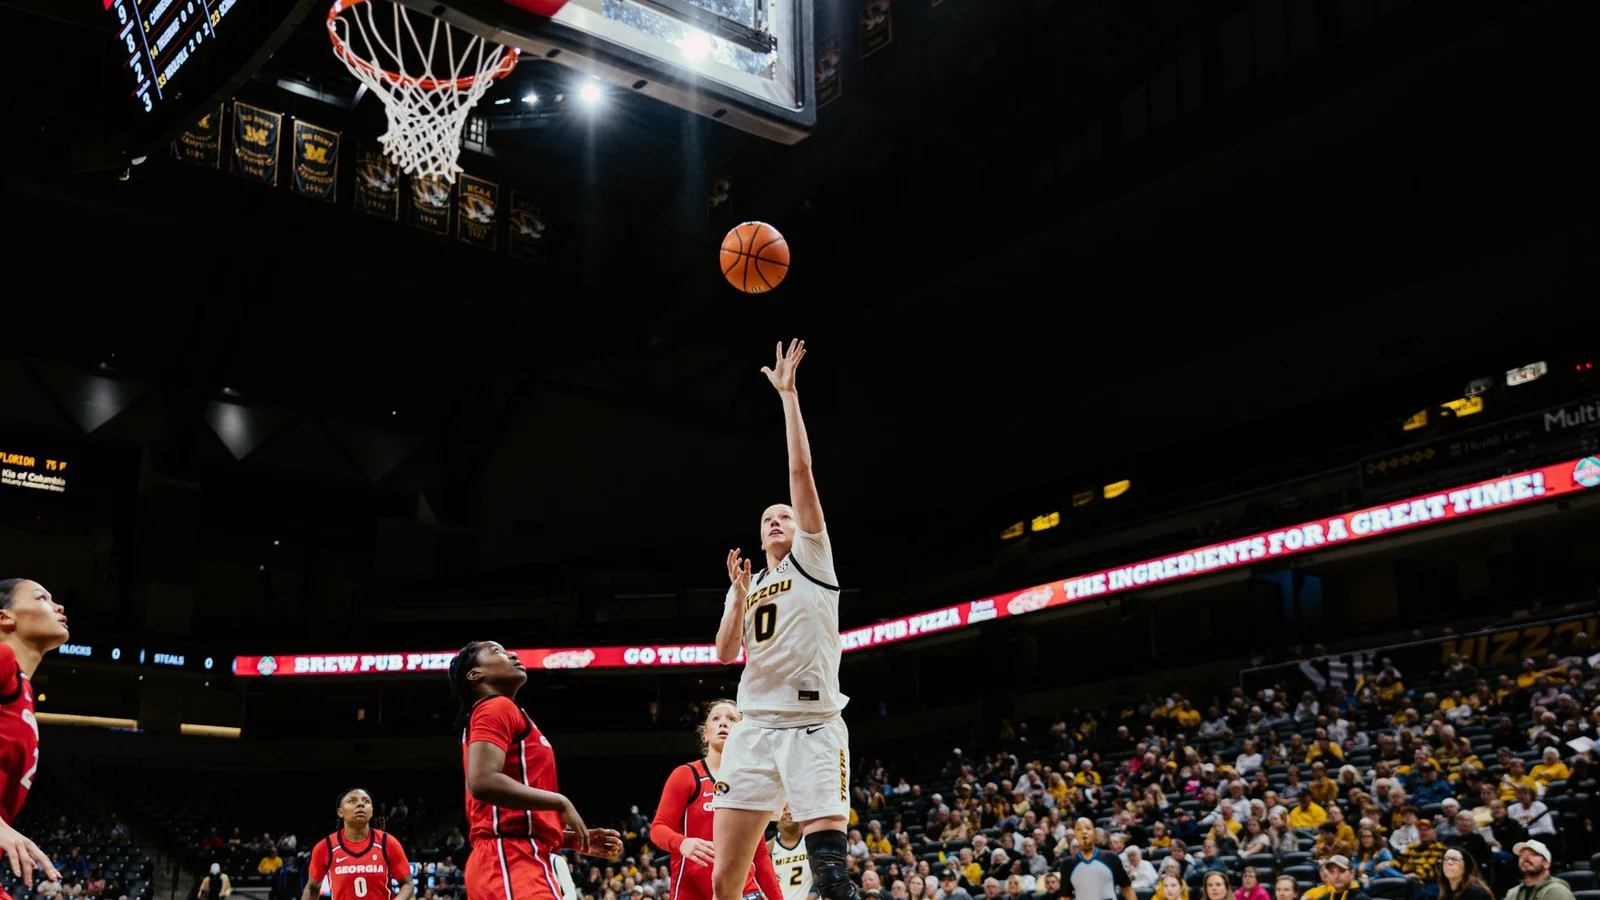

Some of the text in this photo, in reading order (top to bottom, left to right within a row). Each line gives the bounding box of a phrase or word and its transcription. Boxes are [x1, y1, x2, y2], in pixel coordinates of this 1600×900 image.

[118, 4, 127, 25] 9
[180, 10, 188, 23] 0
[187, 1, 194, 15] 0
[210, 9, 221, 28] 23
[126, 33, 136, 54] 8
[188, 39, 196, 53] 2
[195, 31, 202, 44] 0
[202, 22, 210, 36] 2
[134, 61, 145, 84] 2
[142, 91, 153, 113] 3
[466, 183, 492, 198] NCAA
[1063, 574, 1106, 601] THE
[1107, 537, 1267, 591] INGREDIENTS
[1267, 522, 1326, 554] FOR
[1326, 517, 1349, 542] A
[1349, 493, 1449, 535] GREAT
[1448, 471, 1547, 513] TIME!
[753, 602, 779, 645] 0
[839, 627, 873, 650] REW
[873, 621, 908, 643] PUB
[908, 607, 962, 635] PIZZA
[58, 643, 121, 660] BLOCKS 0
[153, 653, 213, 669] STEALS 0
[623, 647, 656, 665] GO
[293, 656, 359, 673] BREW
[359, 654, 404, 671] PUB
[406, 652, 454, 670] PIZZ
[334, 864, 384, 875] GEORGIA
[789, 866, 803, 887] 2
[353, 876, 368, 898] 0
